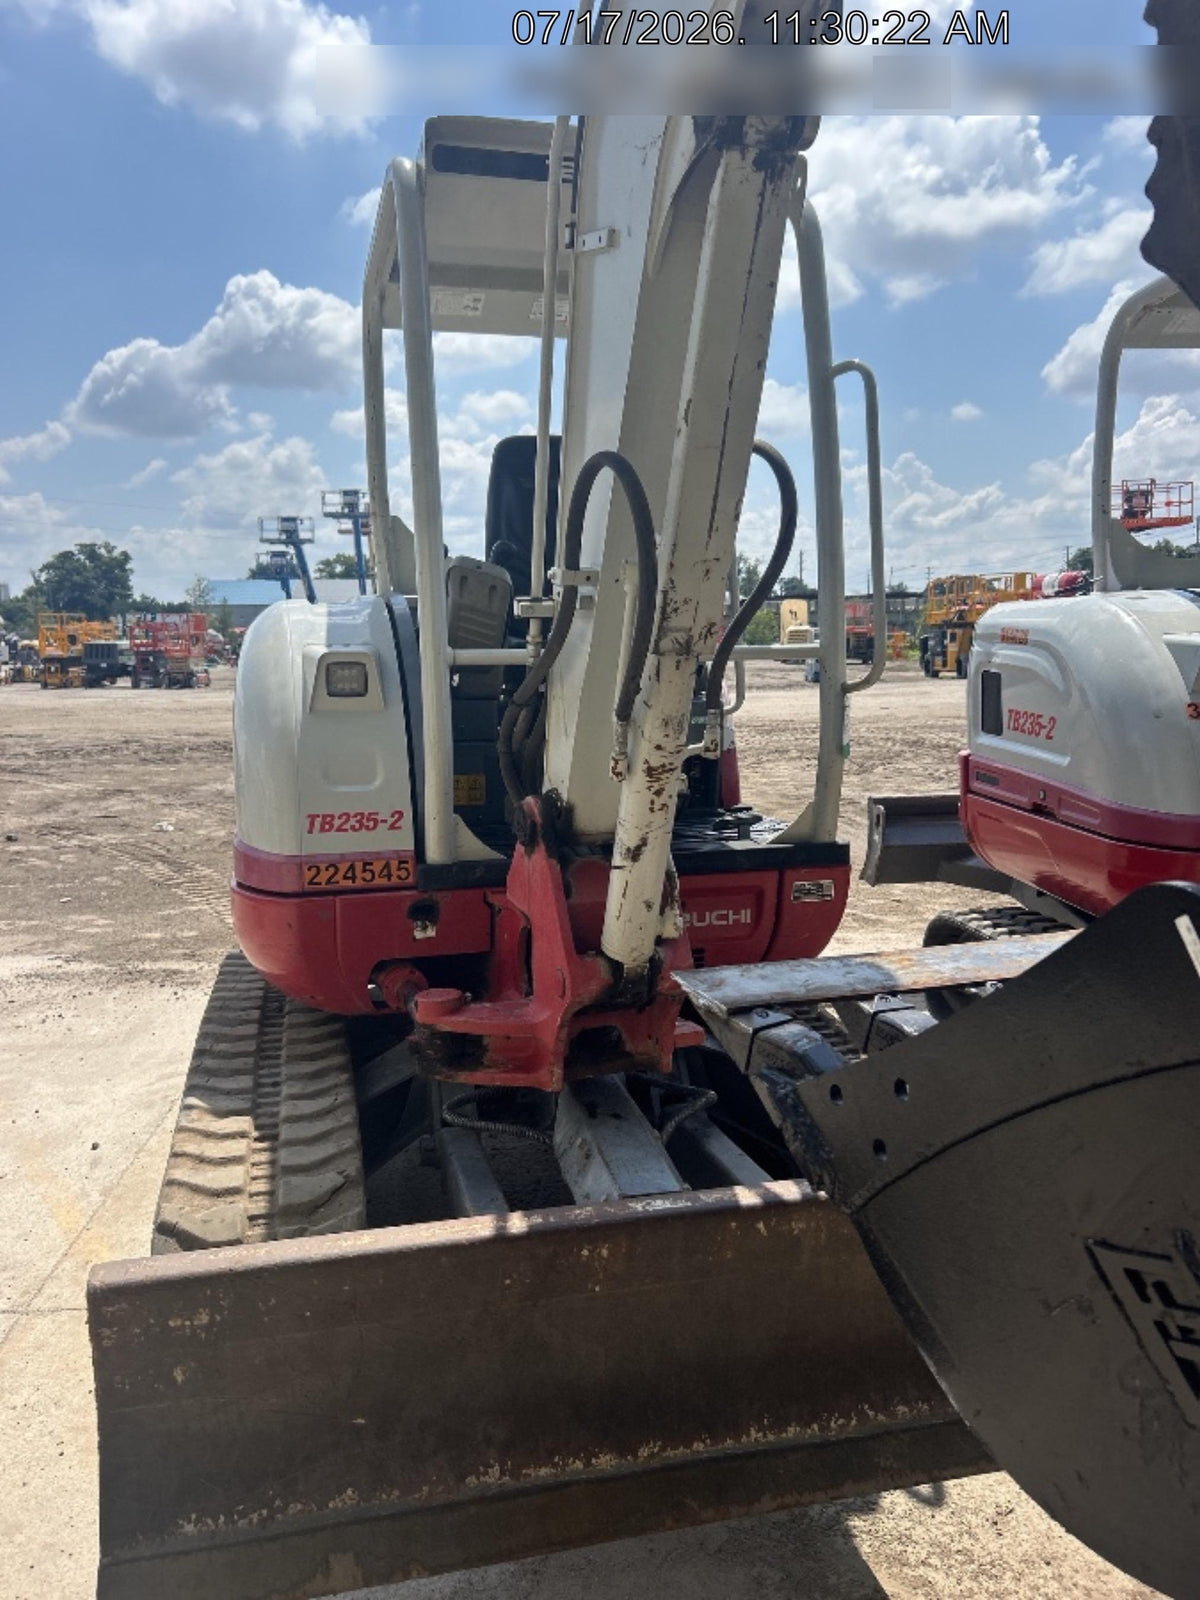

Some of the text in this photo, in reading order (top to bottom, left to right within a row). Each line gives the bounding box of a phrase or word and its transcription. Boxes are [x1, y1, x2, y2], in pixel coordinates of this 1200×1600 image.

[1007, 708, 1057, 740] TB235-2
[306, 810, 404, 834] TB235-2
[306, 860, 411, 886] 224545
